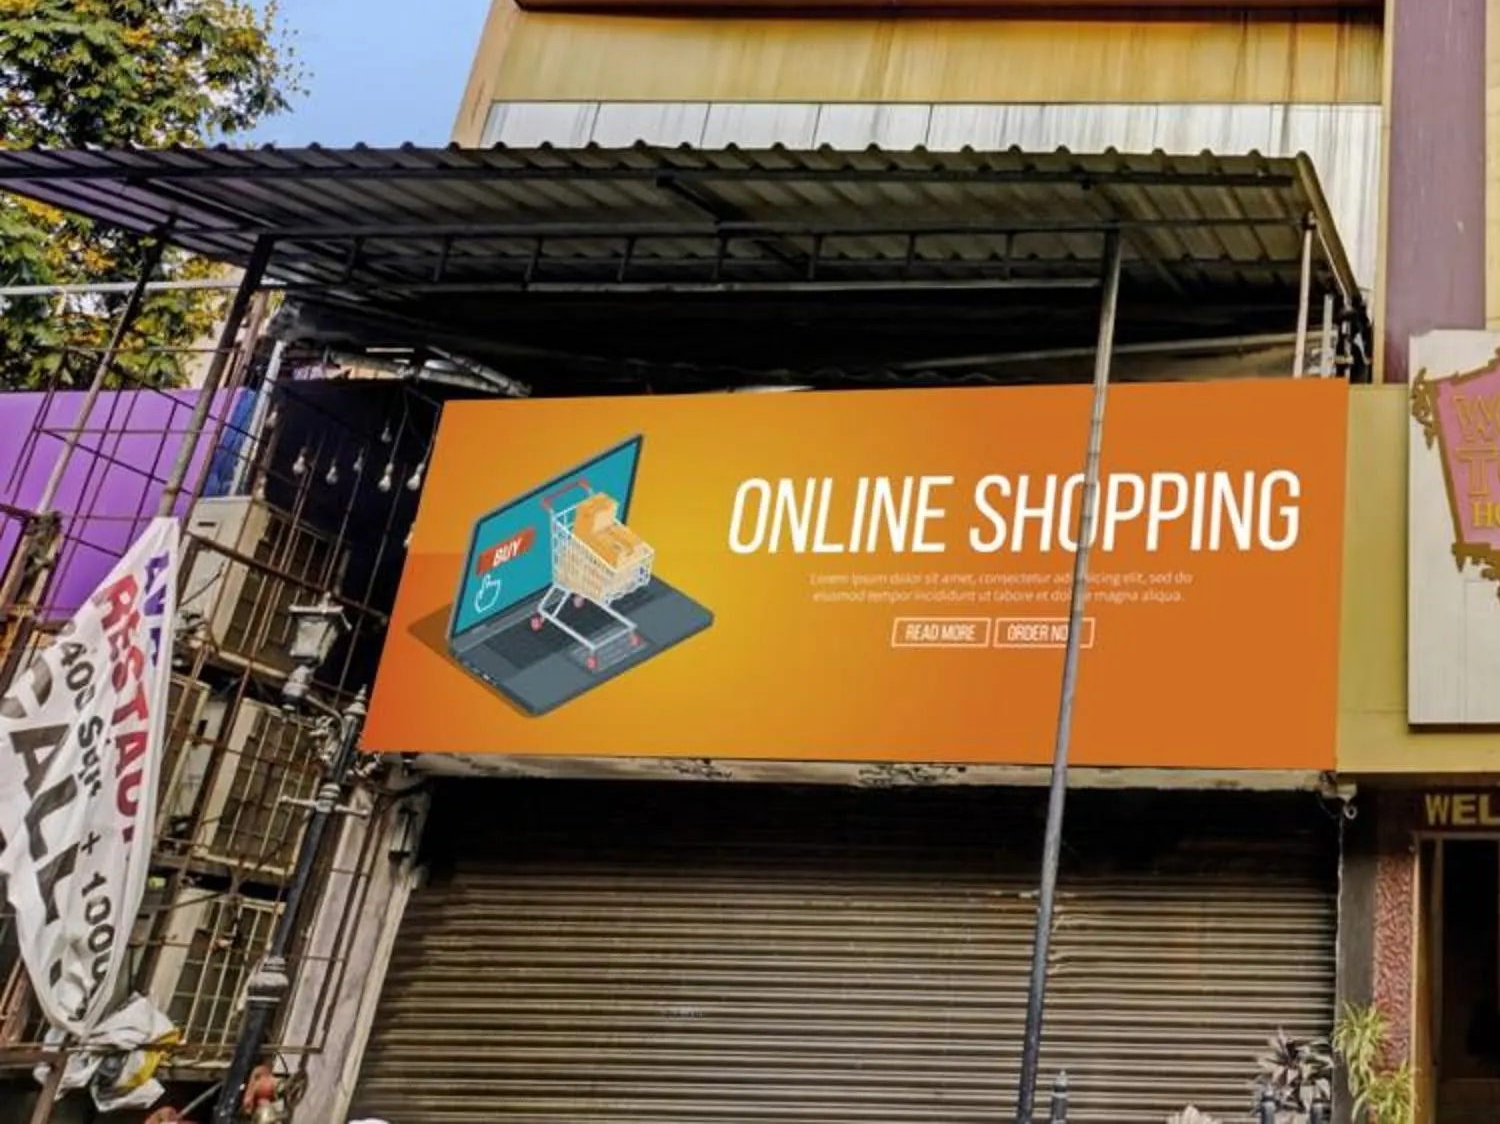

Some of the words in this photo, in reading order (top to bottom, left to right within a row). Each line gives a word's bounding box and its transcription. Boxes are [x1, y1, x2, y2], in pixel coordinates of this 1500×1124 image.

[727, 475, 955, 555] ONLINE
[968, 468, 1302, 554] SHOPPING
[492, 536, 523, 569] BUY
[905, 623, 939, 642] READ
[941, 623, 977, 642] MORE
[1007, 623, 1049, 642] ORDER
[1050, 623, 1072, 642] NO
[100, 573, 149, 845] RESTAU
